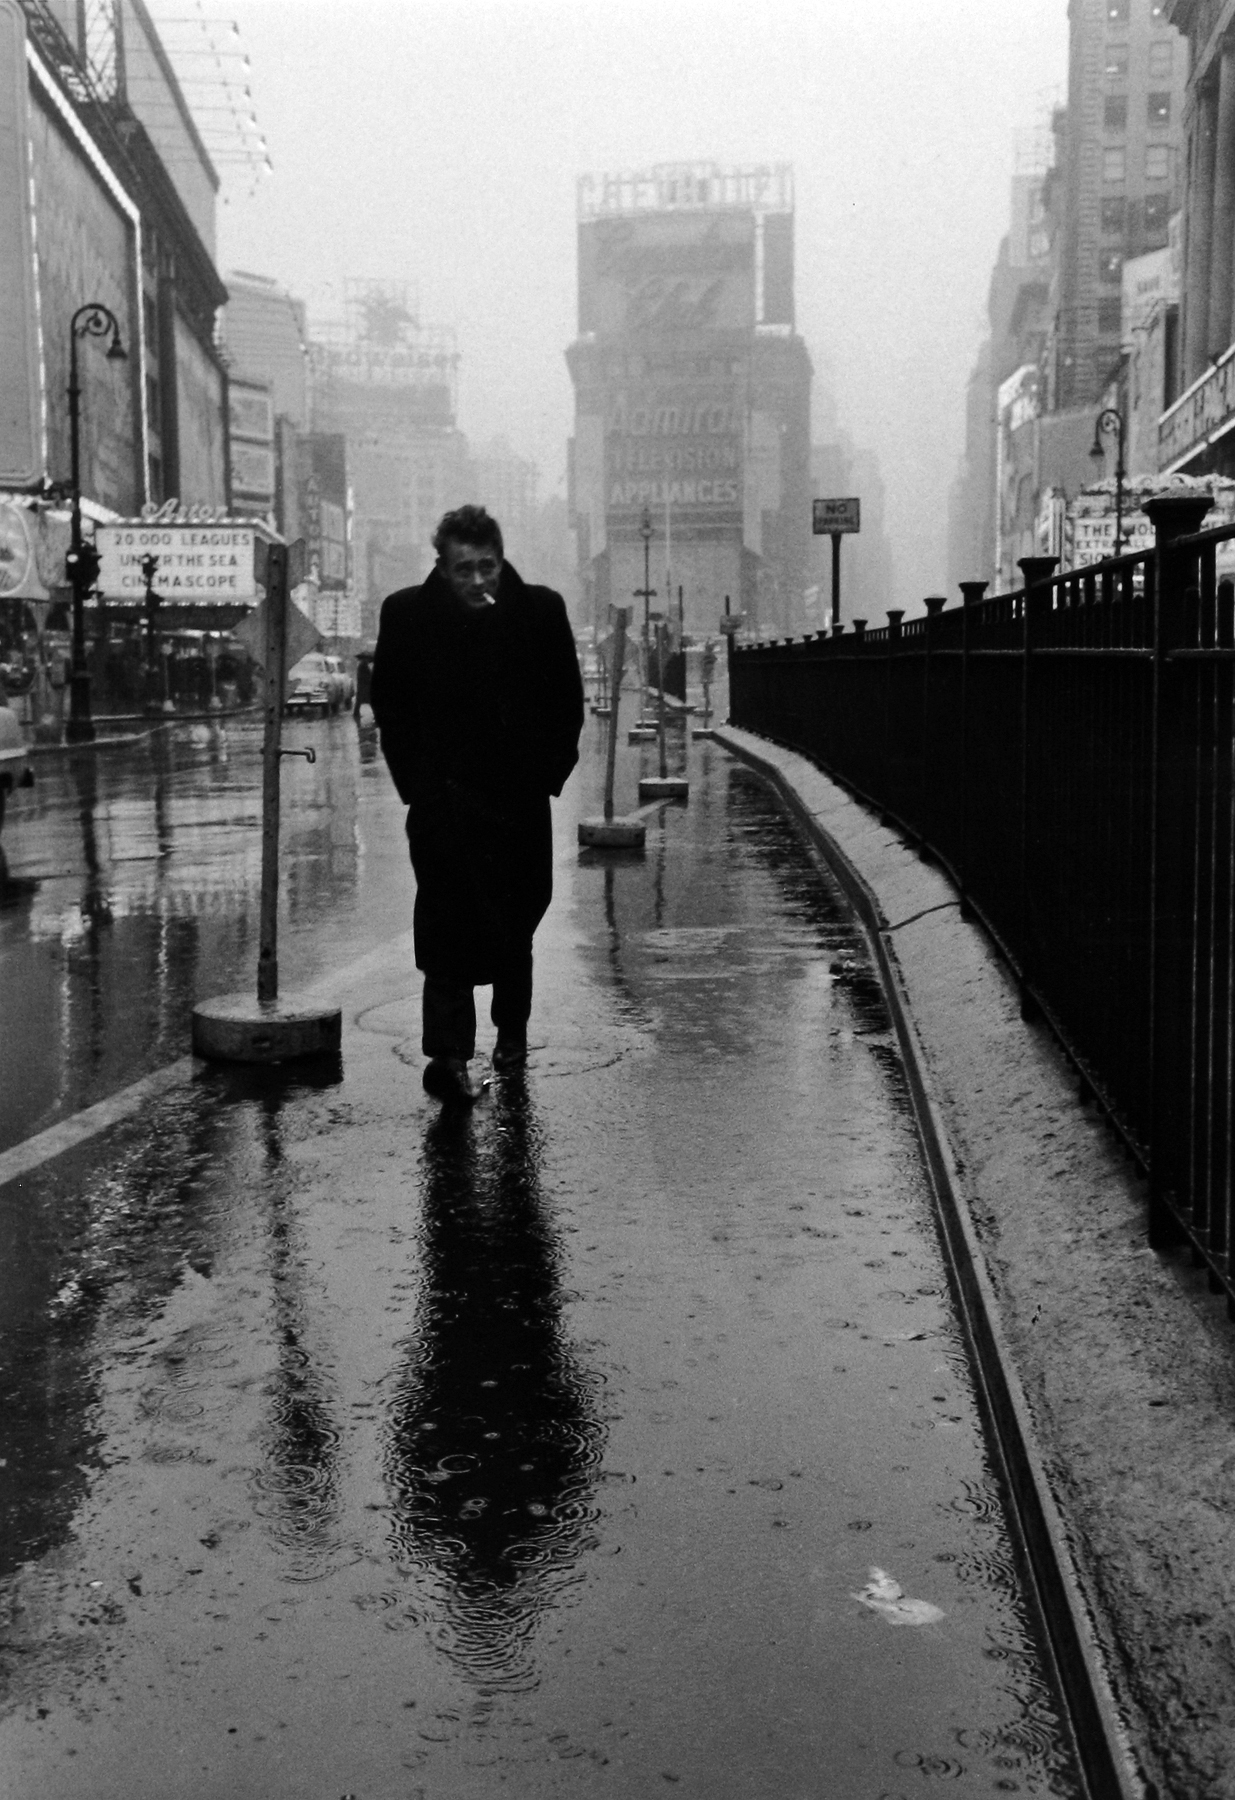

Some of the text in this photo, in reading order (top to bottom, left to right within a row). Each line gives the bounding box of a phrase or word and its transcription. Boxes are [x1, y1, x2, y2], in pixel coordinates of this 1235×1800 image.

[609, 480, 738, 504] APPLIANCES
[141, 497, 228, 520] Astor
[826, 503, 848, 515] NO
[1082, 524, 1111, 537] THE
[181, 533, 250, 546] LEAGUES
[120, 554, 238, 567] UNR THE SEA
